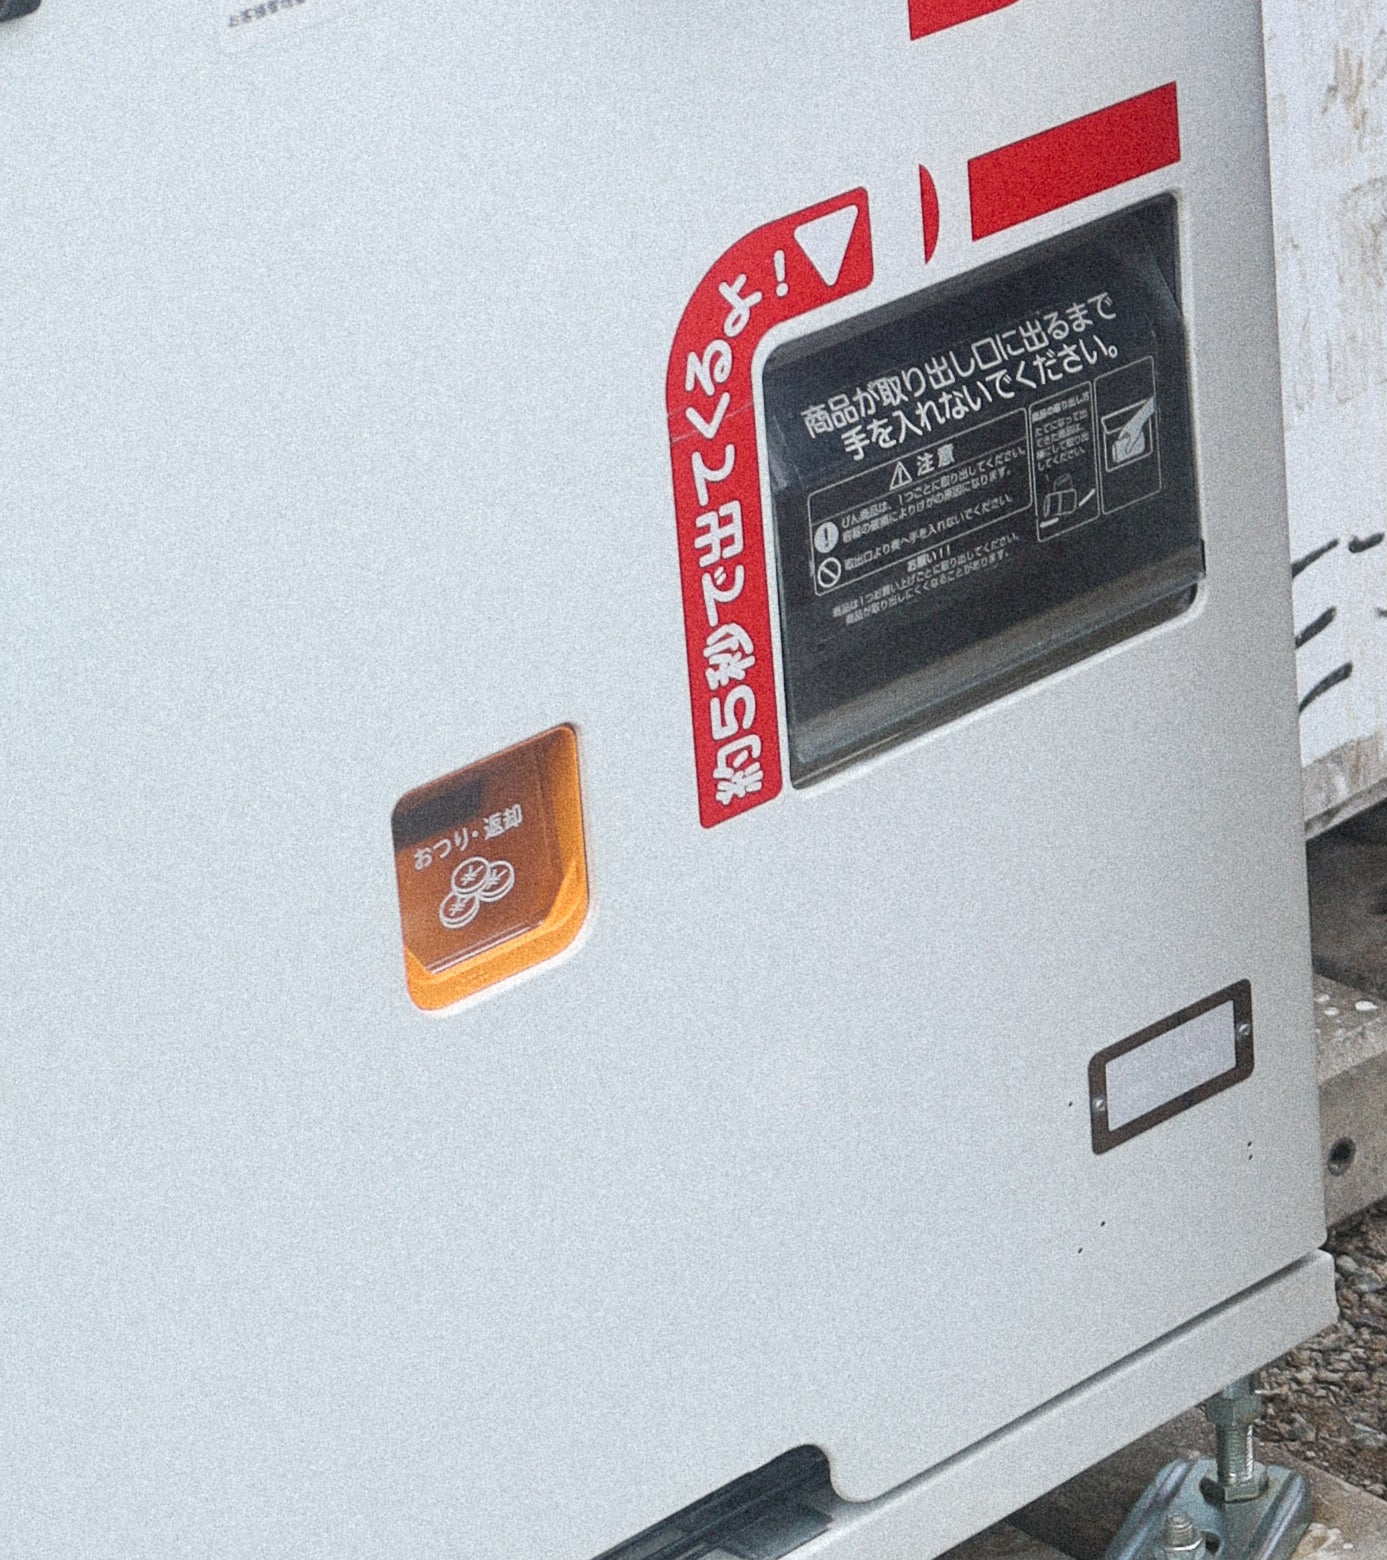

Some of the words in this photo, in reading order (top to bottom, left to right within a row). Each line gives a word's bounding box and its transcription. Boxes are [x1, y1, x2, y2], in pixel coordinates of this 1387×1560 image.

[800, 291, 1117, 439] 商品が取り出し口に出るまで
[840, 334, 1119, 462] 手を入れないでください。
[915, 443, 956, 477] 注意
